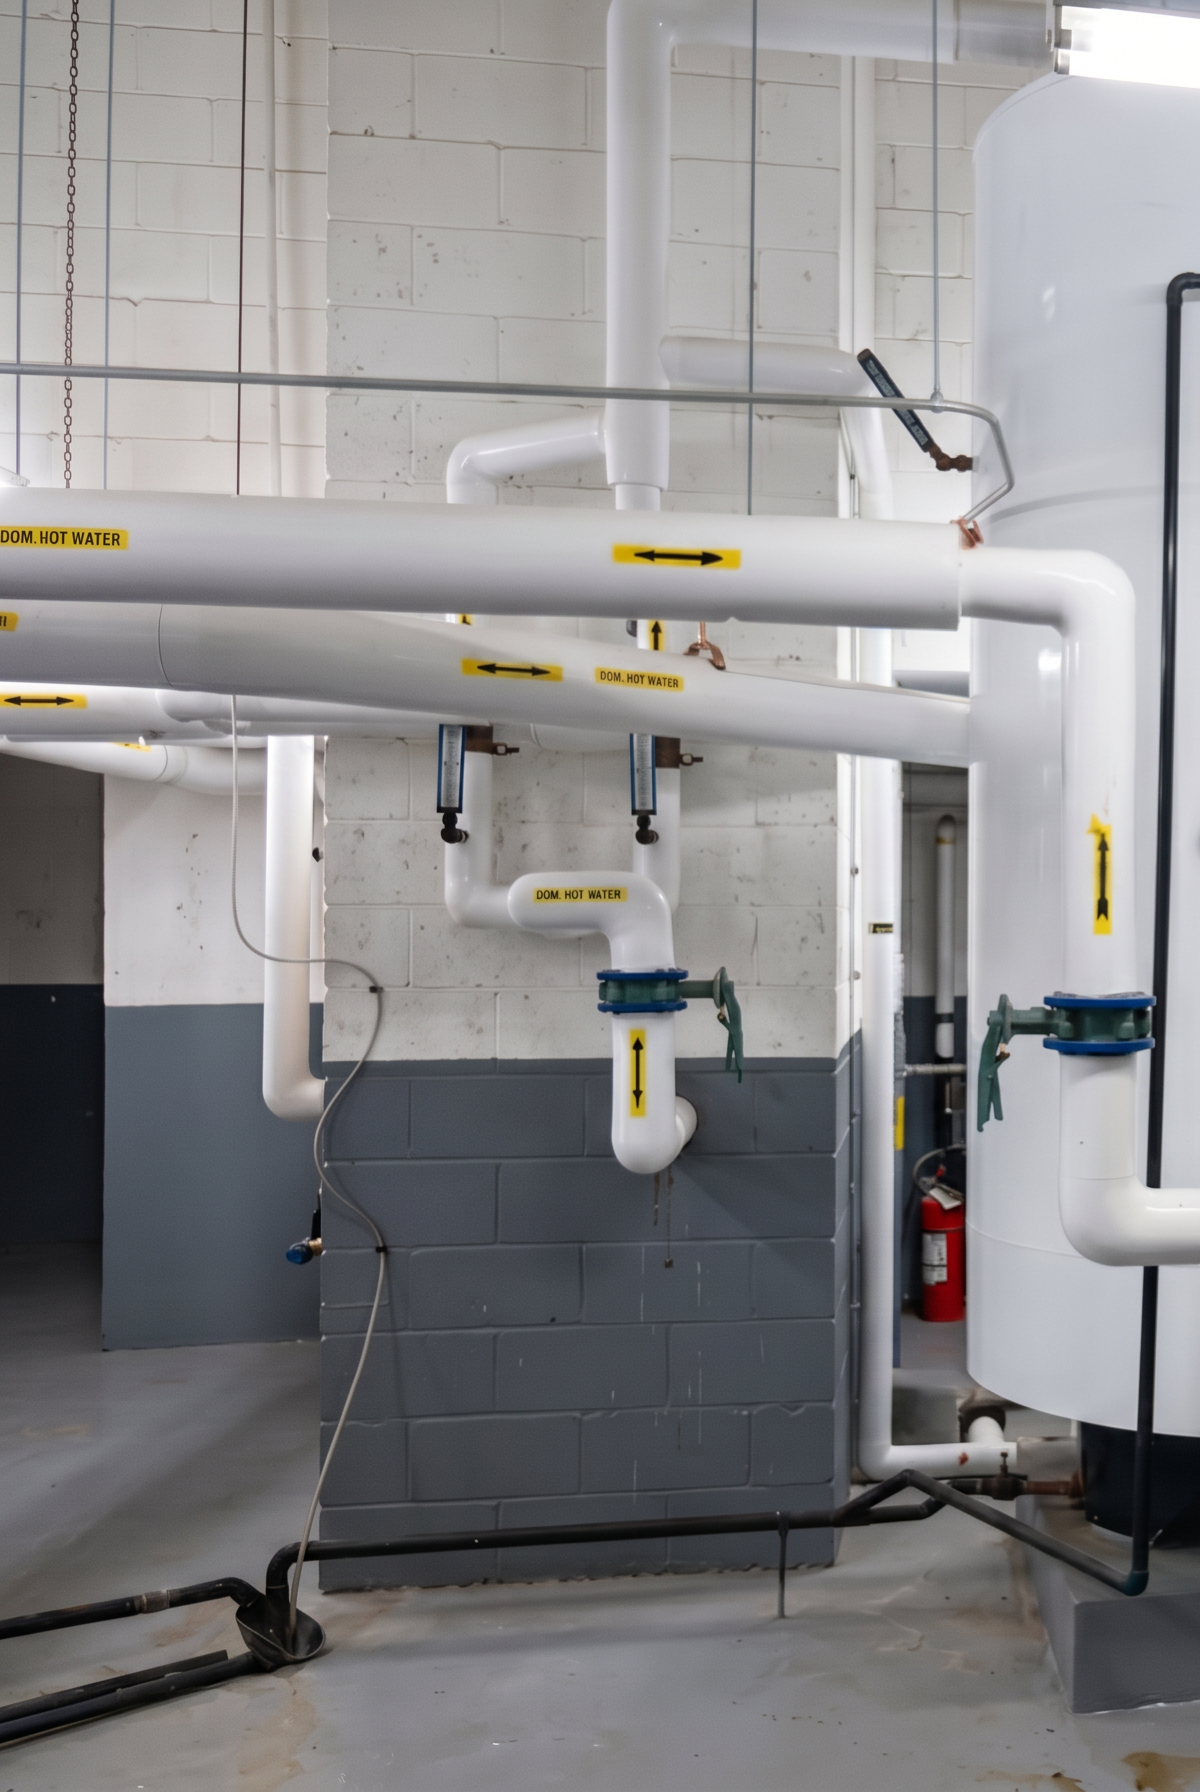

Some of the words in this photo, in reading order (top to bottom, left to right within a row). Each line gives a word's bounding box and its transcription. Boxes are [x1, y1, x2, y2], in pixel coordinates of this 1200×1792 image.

[0, 530, 37, 544] DOM.
[40, 531, 68, 545] HOT
[72, 531, 121, 546] WATER
[600, 671, 624, 683] DOM.
[647, 675, 679, 688] WATER
[536, 889, 561, 900] DOM.
[564, 889, 584, 900] HOT
[588, 889, 621, 900] WATER
